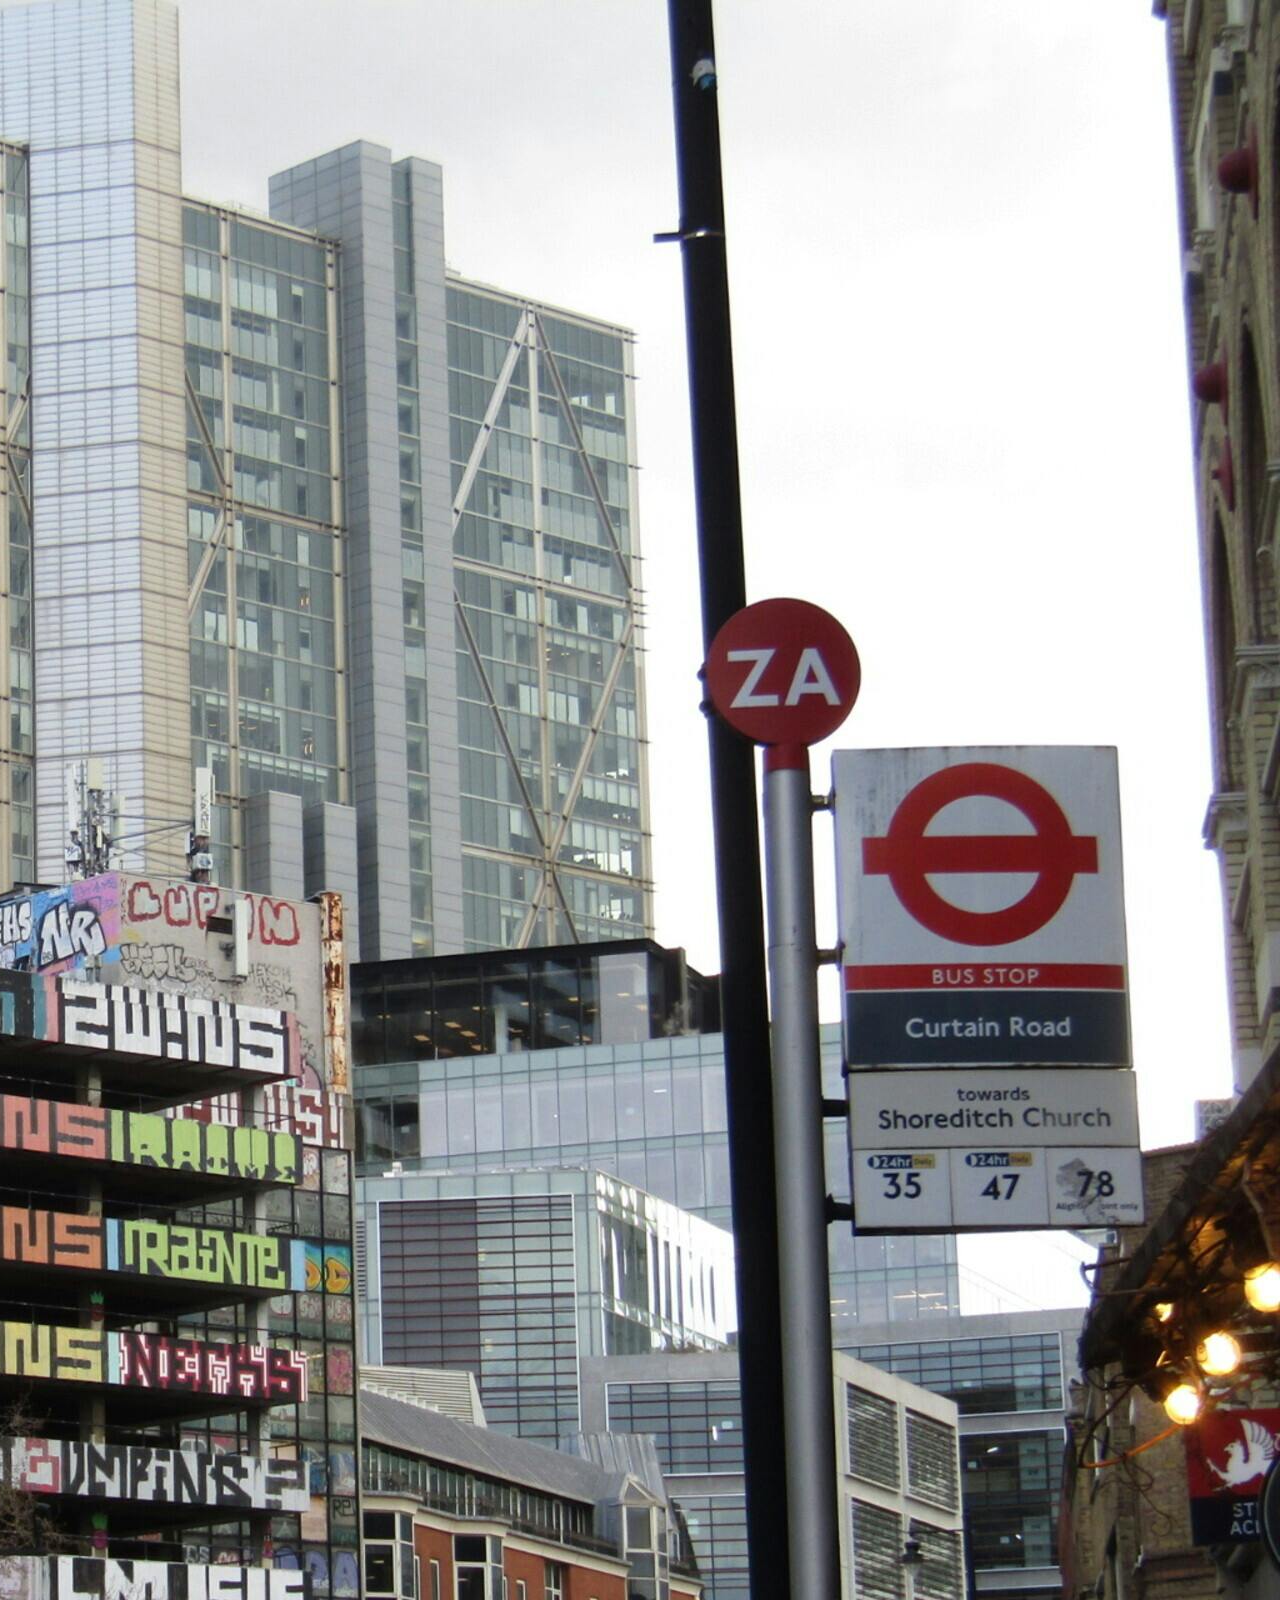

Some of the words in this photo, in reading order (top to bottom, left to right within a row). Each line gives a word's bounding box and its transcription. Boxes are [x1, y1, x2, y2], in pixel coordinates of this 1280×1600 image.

[727, 647, 841, 709] ZA
[932, 968, 975, 985] BUS
[983, 968, 1040, 985] STOP
[905, 1017, 1000, 1039] Curtain
[1009, 1016, 1072, 1038] Road
[957, 1086, 1031, 1102] towards
[878, 1108, 1014, 1131] Shoreditch
[1022, 1106, 1112, 1129] Church
[880, 1155, 913, 1168] 24hr
[977, 1153, 1009, 1167] 24hr
[882, 1172, 922, 1200] 35
[980, 1173, 1020, 1201] 47
[1077, 1169, 1115, 1198] 78
